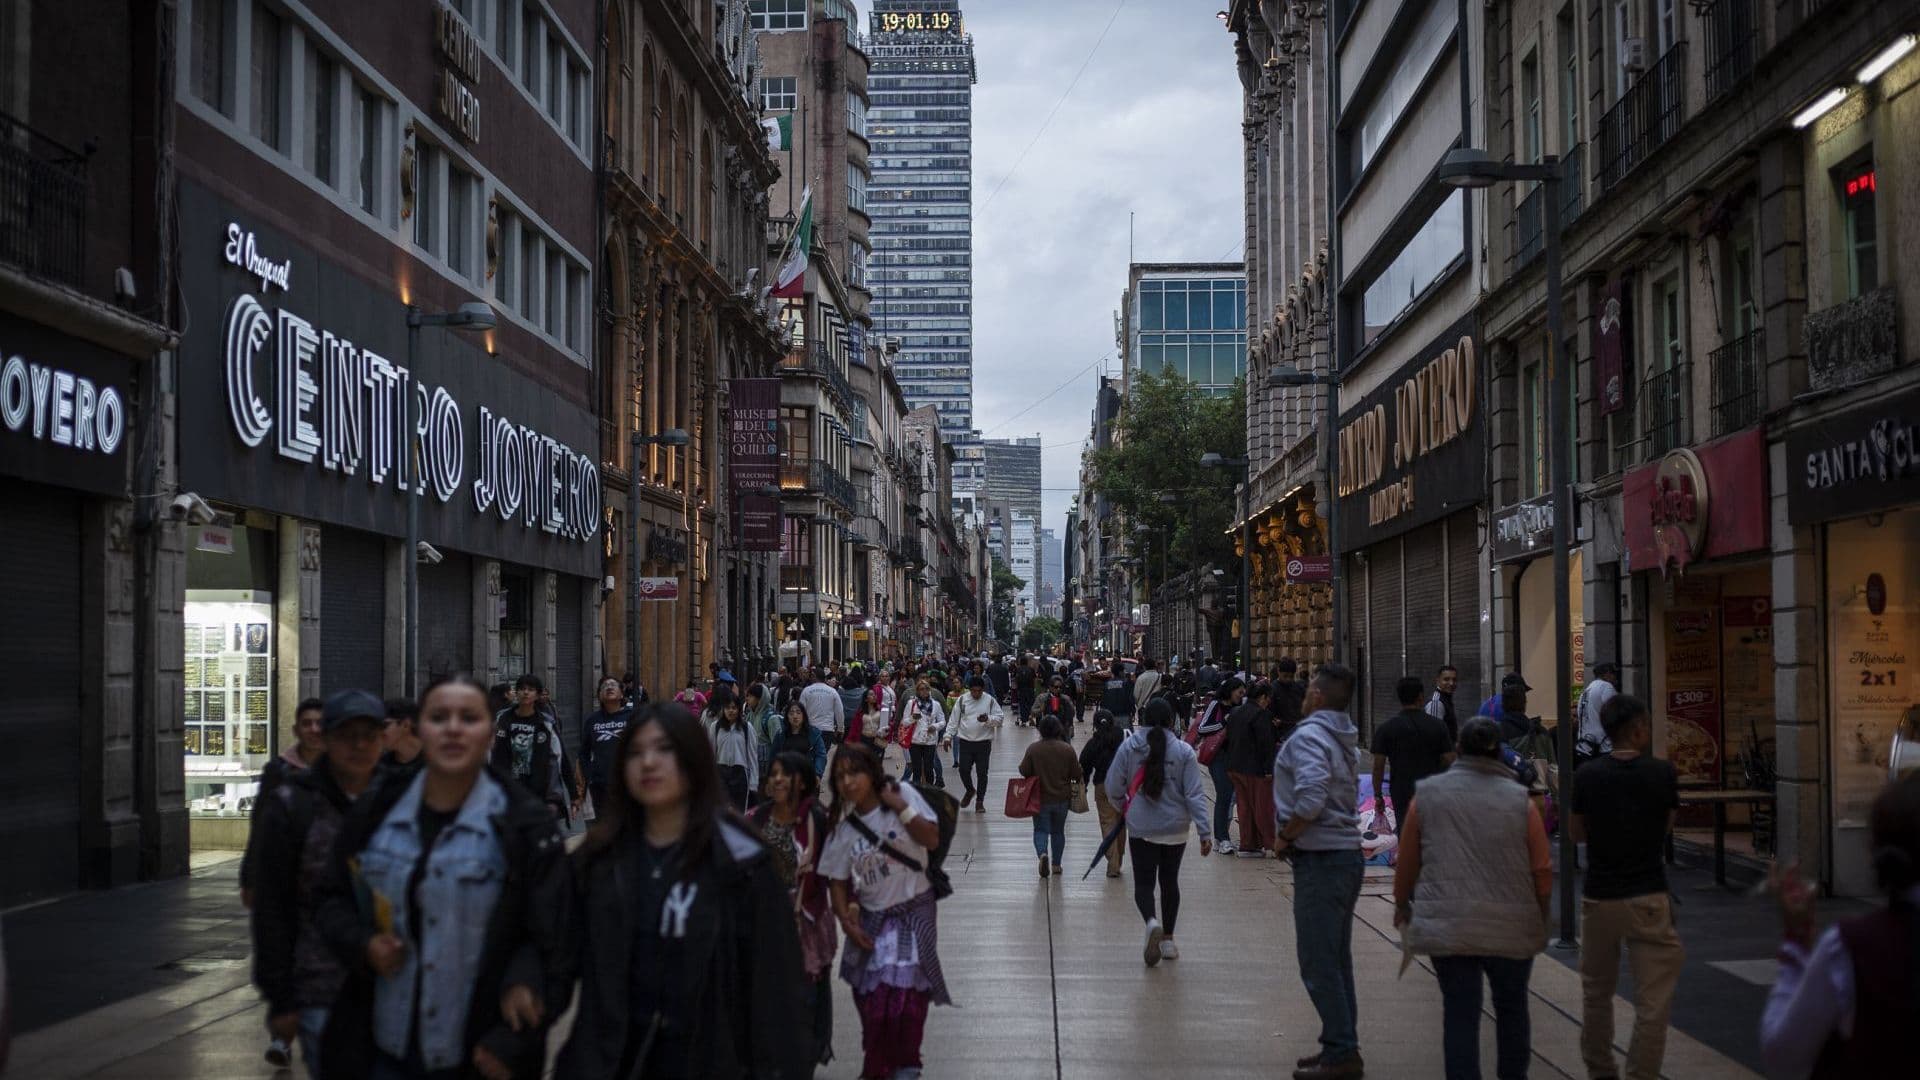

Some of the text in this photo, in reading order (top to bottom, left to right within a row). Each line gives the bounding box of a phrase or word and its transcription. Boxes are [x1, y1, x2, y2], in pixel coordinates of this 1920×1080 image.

[864, 46, 966, 56] LATINOAMERICANA
[440, 68, 480, 144] JOYERO
[225, 222, 244, 267] El
[0, 354, 124, 454] OYERO
[227, 292, 600, 542] CENTRO JOYERO
[1338, 335, 1477, 497] ENTRO JOYERO
[1807, 440, 1872, 488] SANTA
[1861, 670, 1897, 686] 2x1
[659, 881, 699, 939] NY
